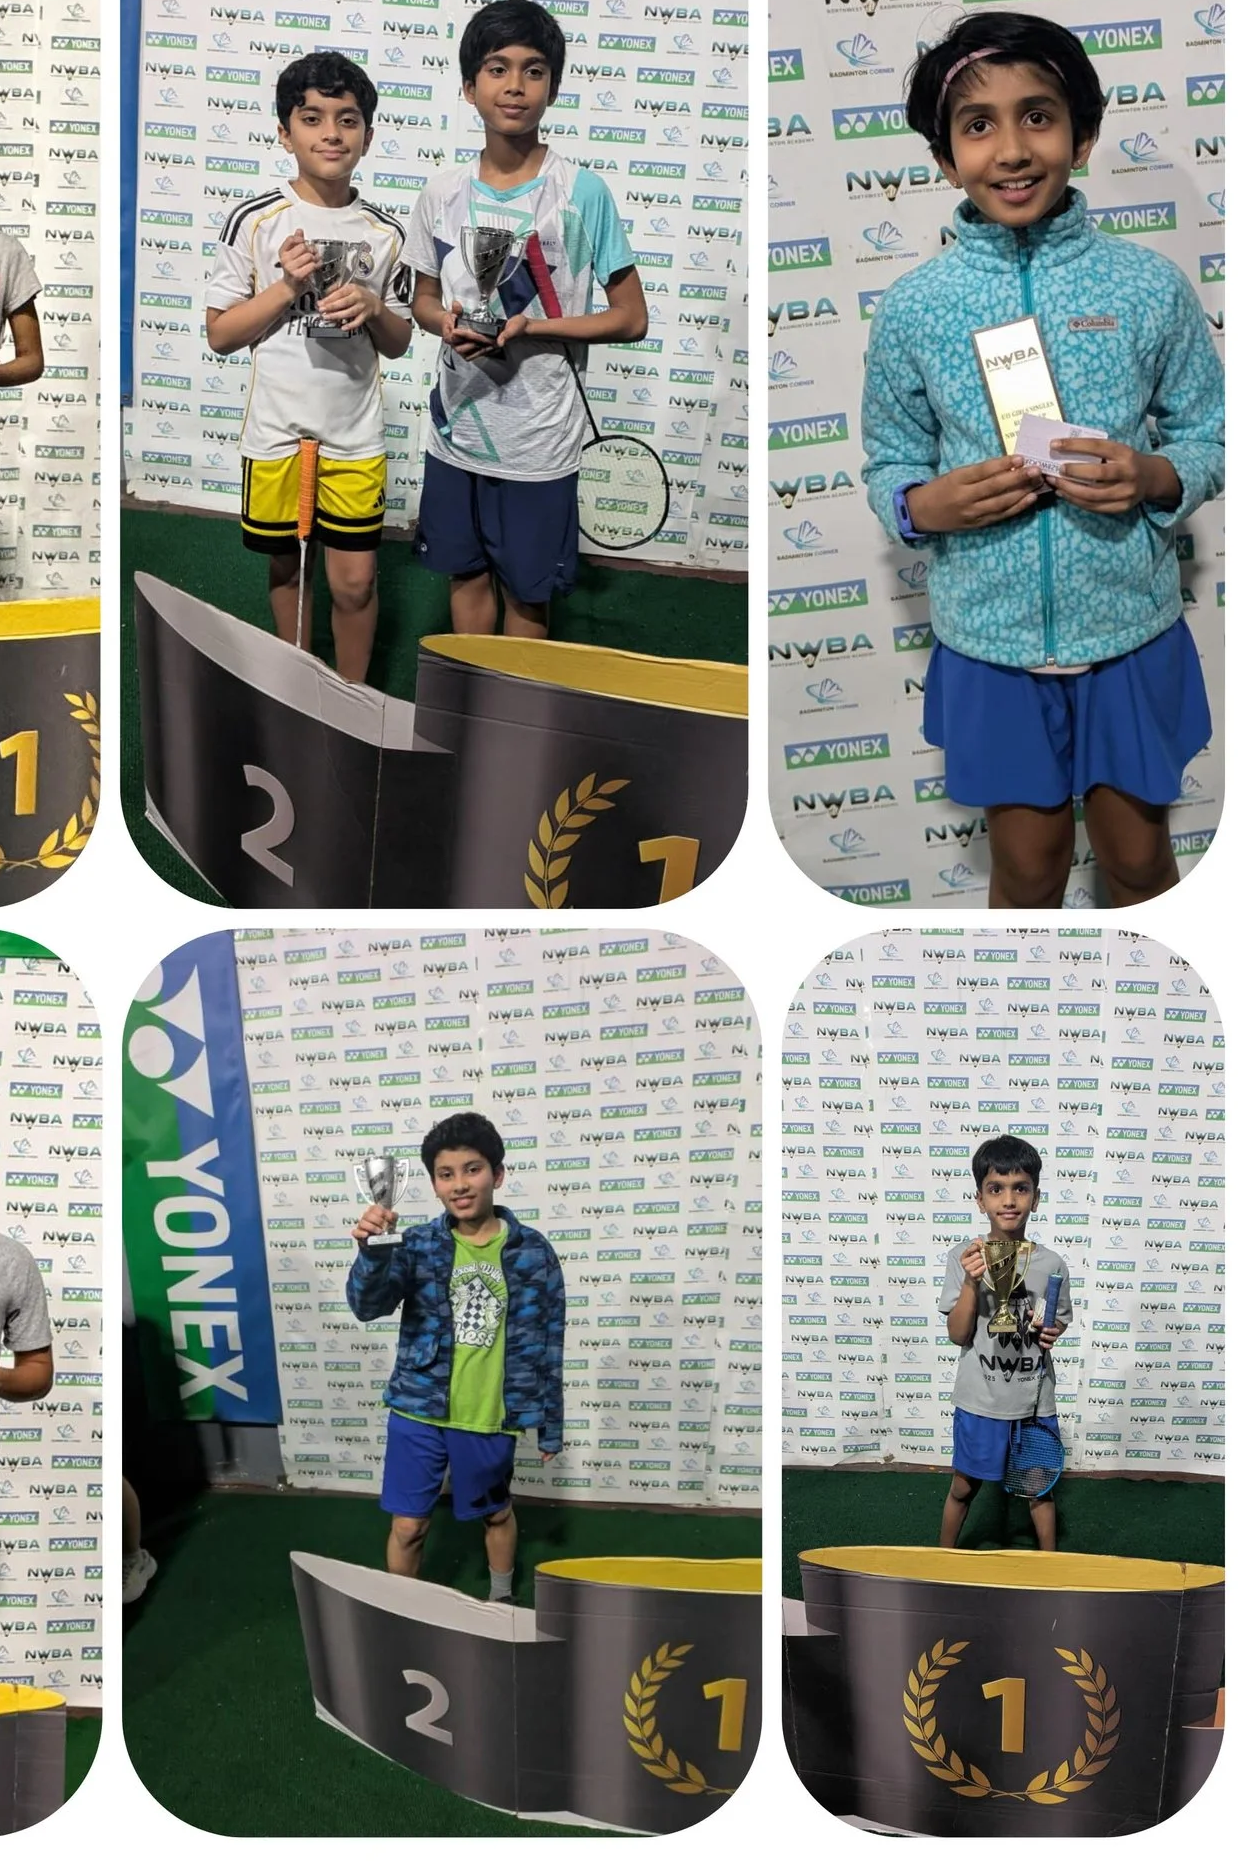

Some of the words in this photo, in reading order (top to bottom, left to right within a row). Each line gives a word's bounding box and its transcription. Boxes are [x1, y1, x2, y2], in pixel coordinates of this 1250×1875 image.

[1094, 26, 1154, 48] YONEX
[829, 70, 867, 78] BADMINTON
[846, 166, 946, 192] NWBA
[1112, 166, 1148, 174] BADMINTON
[1109, 208, 1169, 230] YONEX
[856, 255, 893, 263] BADMINTON
[985, 347, 1039, 369] NWBA
[779, 419, 840, 444] YONEX
[800, 585, 861, 608] YONEX
[769, 633, 874, 660] NWBA
[824, 738, 882, 759] YONEX
[0, 731, 39, 816] 1
[793, 785, 895, 811] NWBA
[241, 765, 294, 887] 2
[368, 939, 412, 952] NWBA
[543, 946, 590, 961] NWBA
[617, 942, 647, 955] YONEX
[922, 950, 965, 960] NWBA
[991, 951, 1016, 961] YONEX
[1132, 982, 1158, 993] YONEX
[147, 1138, 249, 1402] YONEX
[455, 1322, 495, 1347] hess
[402, 1669, 453, 1746] 2
[703, 1678, 748, 1751] 1
[981, 1678, 1025, 1753] 1
